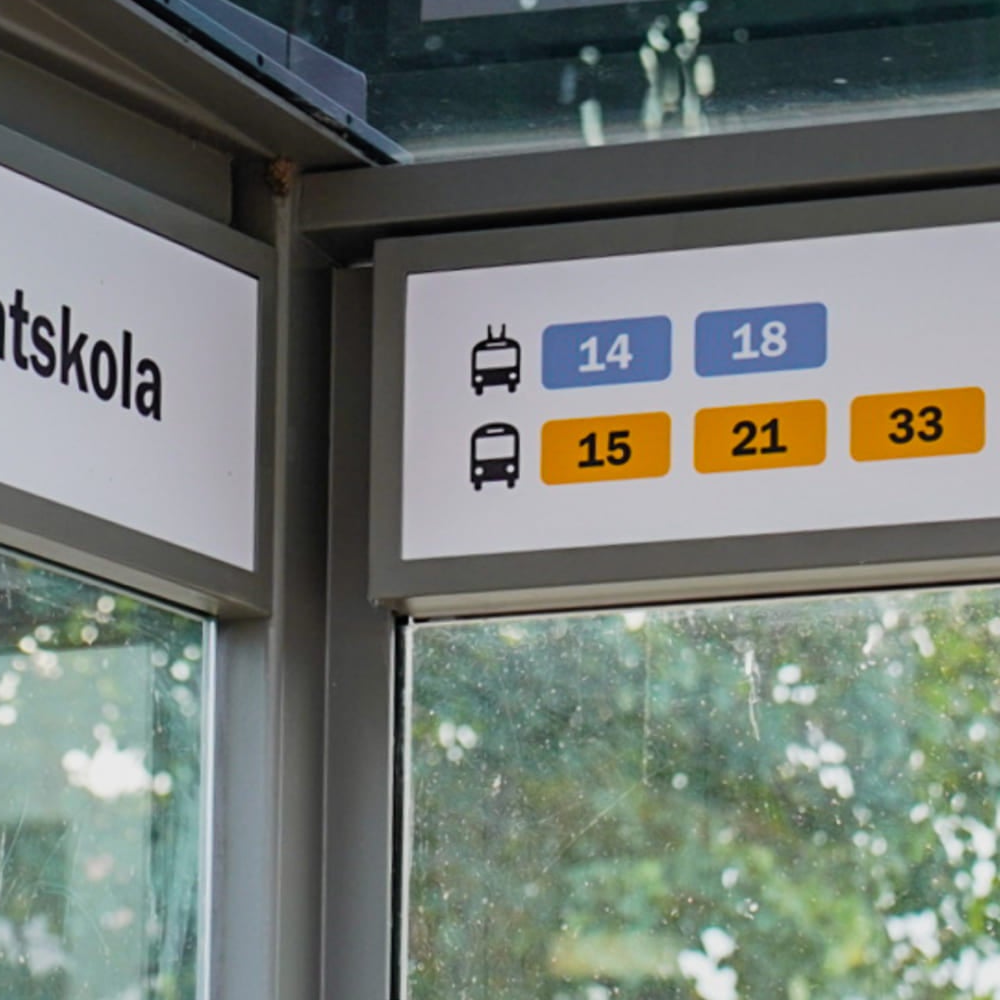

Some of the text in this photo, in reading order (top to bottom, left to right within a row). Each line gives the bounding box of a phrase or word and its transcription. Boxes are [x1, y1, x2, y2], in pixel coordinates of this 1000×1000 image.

[578, 322, 787, 372] 14 18
[577, 406, 944, 468] 15 21 33
